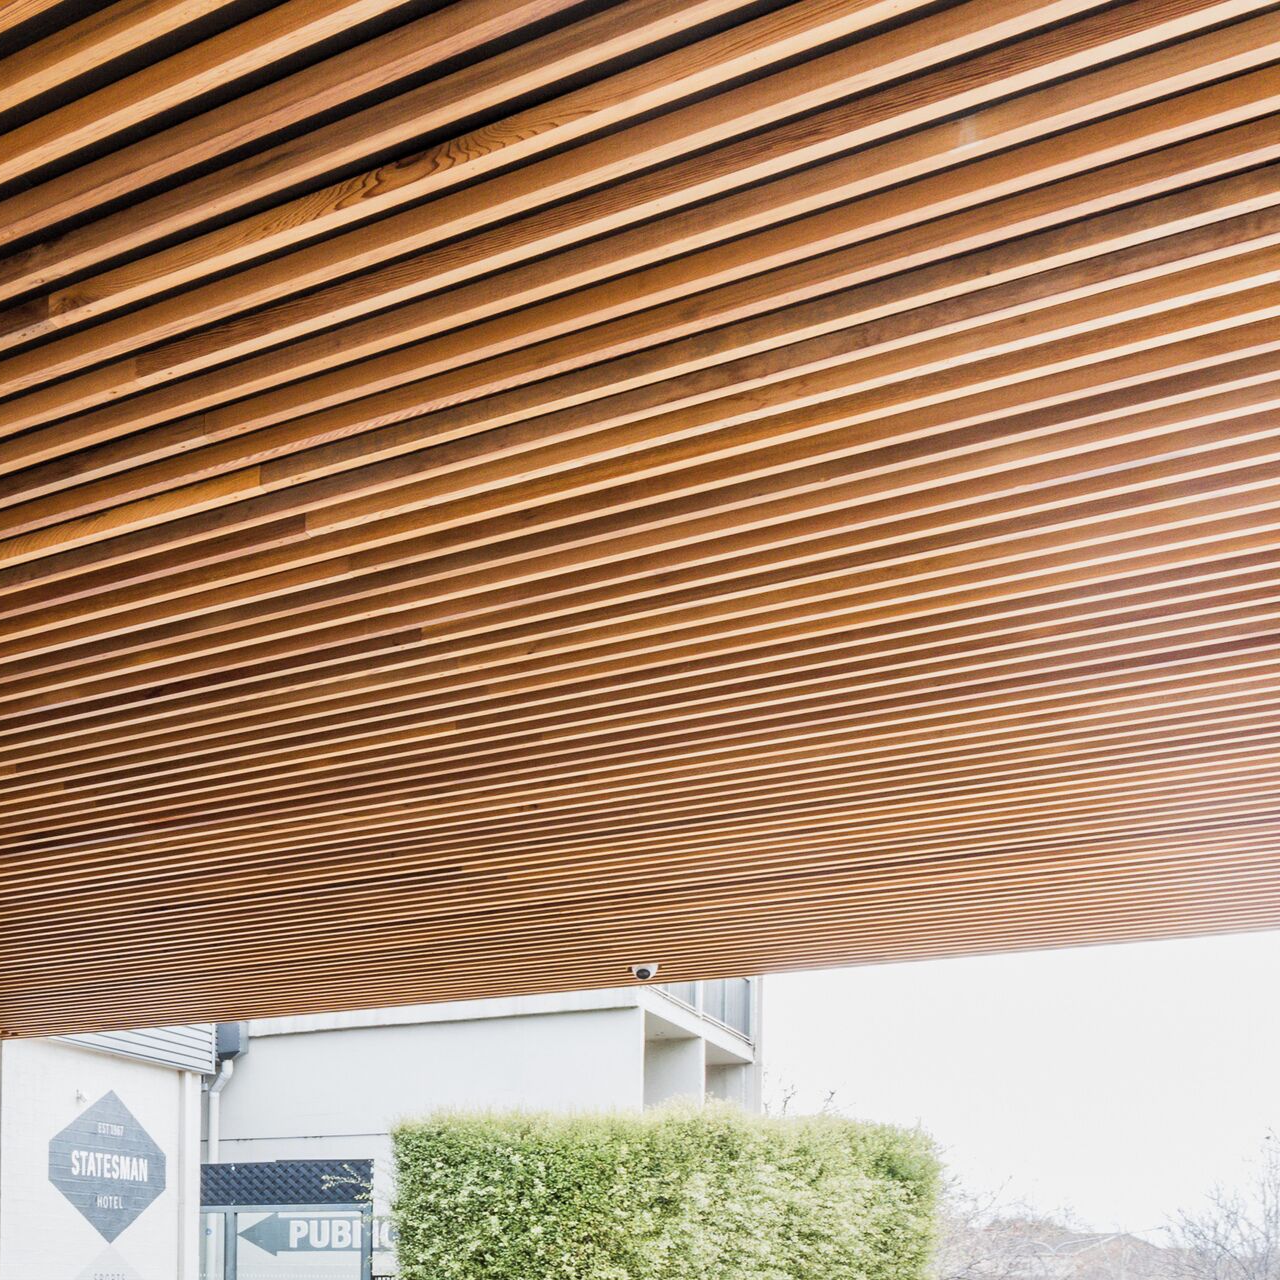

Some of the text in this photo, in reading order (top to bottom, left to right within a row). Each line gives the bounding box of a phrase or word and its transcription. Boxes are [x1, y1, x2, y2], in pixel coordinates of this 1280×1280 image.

[97, 1122, 111, 1135] EST
[71, 1150, 148, 1183] STATESMAN
[97, 1195, 123, 1209] HOTEL
